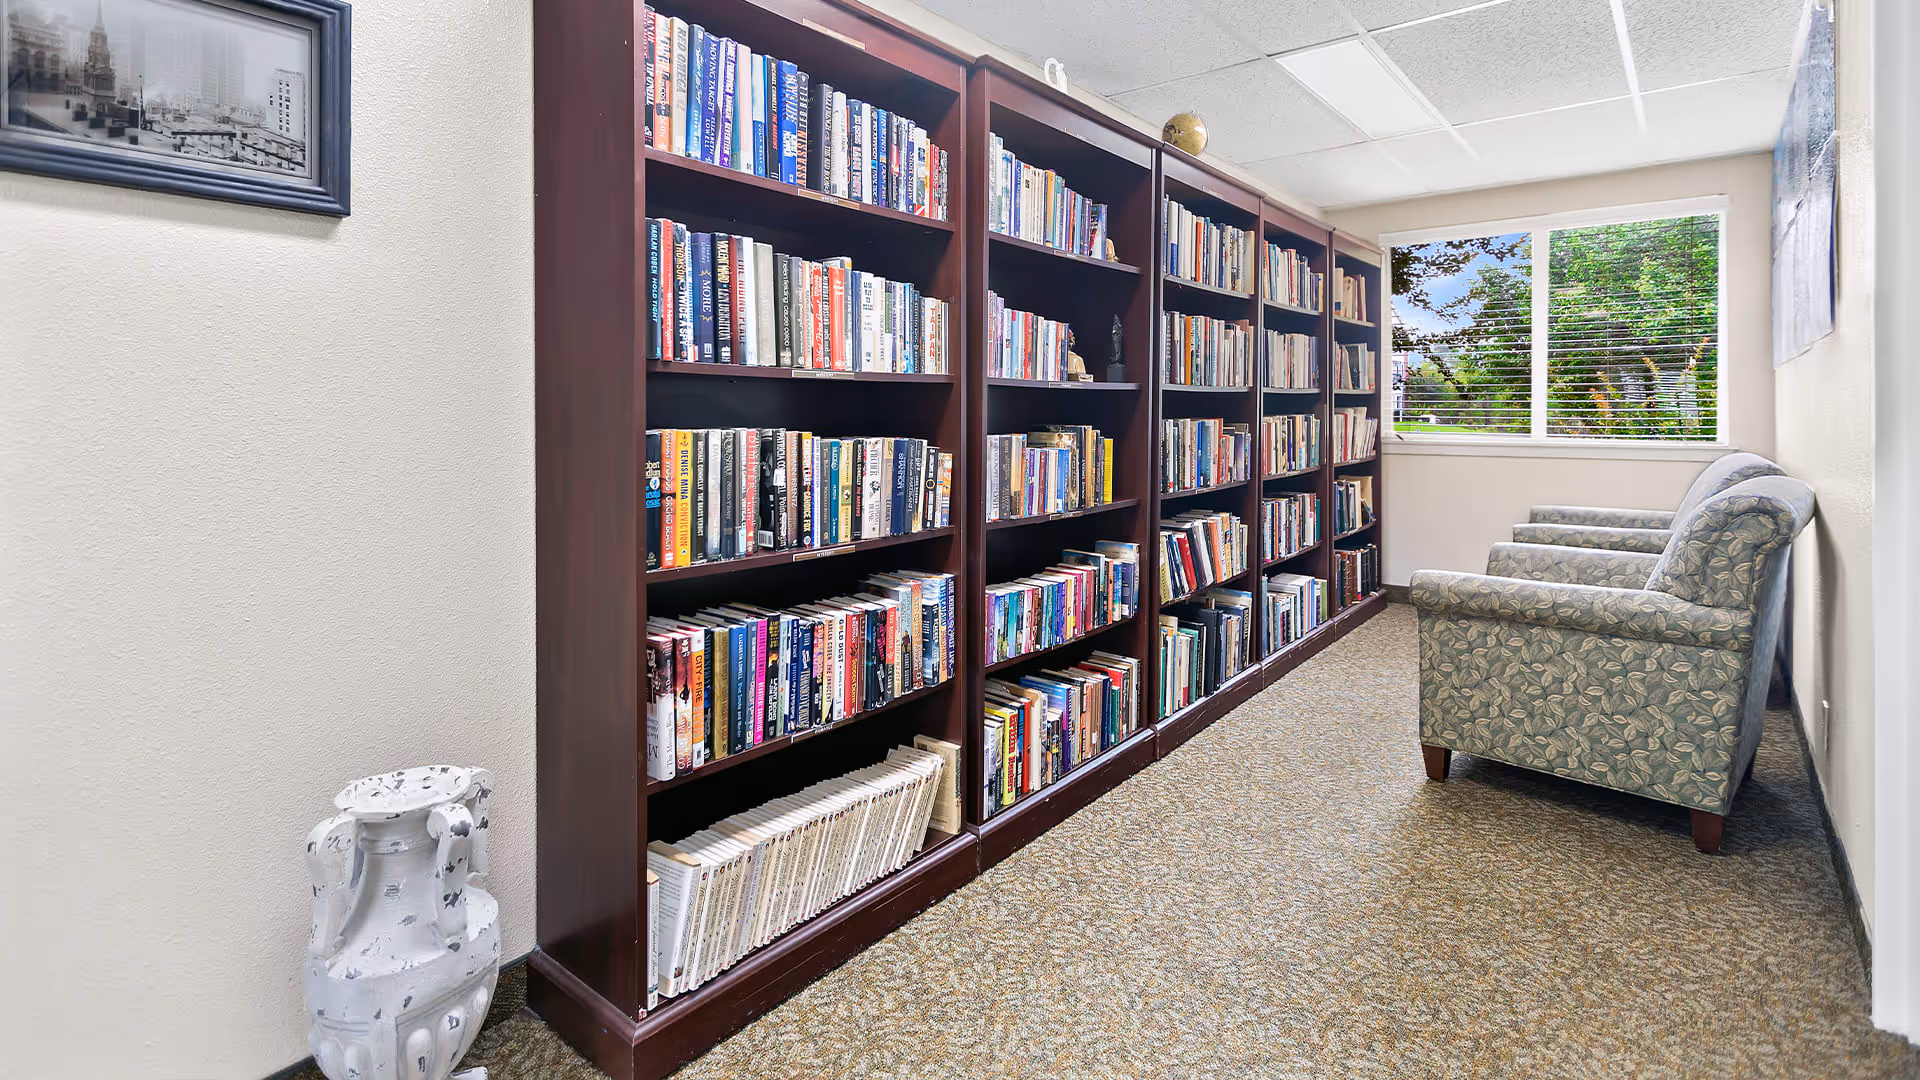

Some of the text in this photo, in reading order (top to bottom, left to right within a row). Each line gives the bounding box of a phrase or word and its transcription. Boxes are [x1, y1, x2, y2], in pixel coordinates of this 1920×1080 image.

[676, 27, 686, 92] RED OMEGA
[707, 41, 717, 113] MOVING TARGET
[800, 86, 808, 110] BELL
[797, 130, 806, 185] ASSASSIN
[853, 146, 861, 170] BROWN
[852, 172, 861, 197] SANDRA
[676, 243, 685, 280] THOMSON
[678, 291, 687, 318] TWICE
[702, 280, 711, 312] MORE
[717, 240, 731, 340] VIOLENT WARD LEN DEIGHTON
[680, 327, 688, 345] SPY
[776, 433, 786, 460] PATRICIA
[680, 502, 688, 546] CONVICTION
[1008, 714, 1018, 754] Griffin
